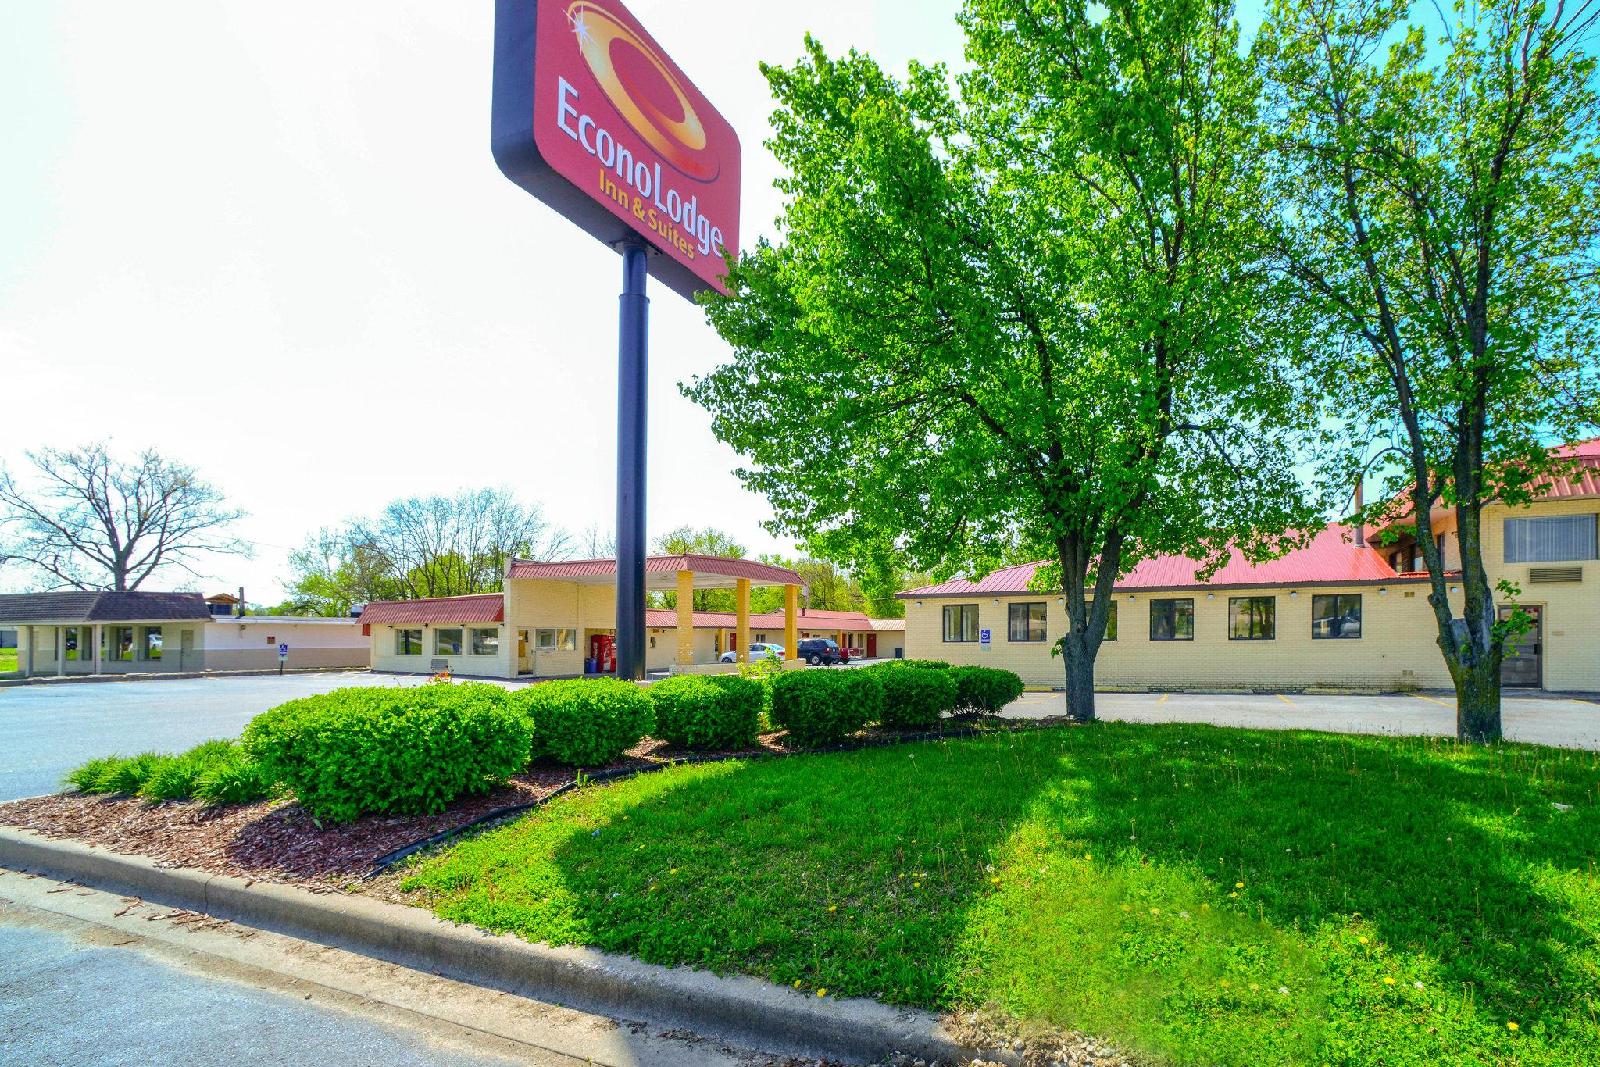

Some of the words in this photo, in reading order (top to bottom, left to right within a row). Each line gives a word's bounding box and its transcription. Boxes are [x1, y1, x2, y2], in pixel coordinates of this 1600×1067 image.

[599, 169, 629, 210] Inn
[632, 197, 646, 222] &
[648, 208, 696, 260] Suites
